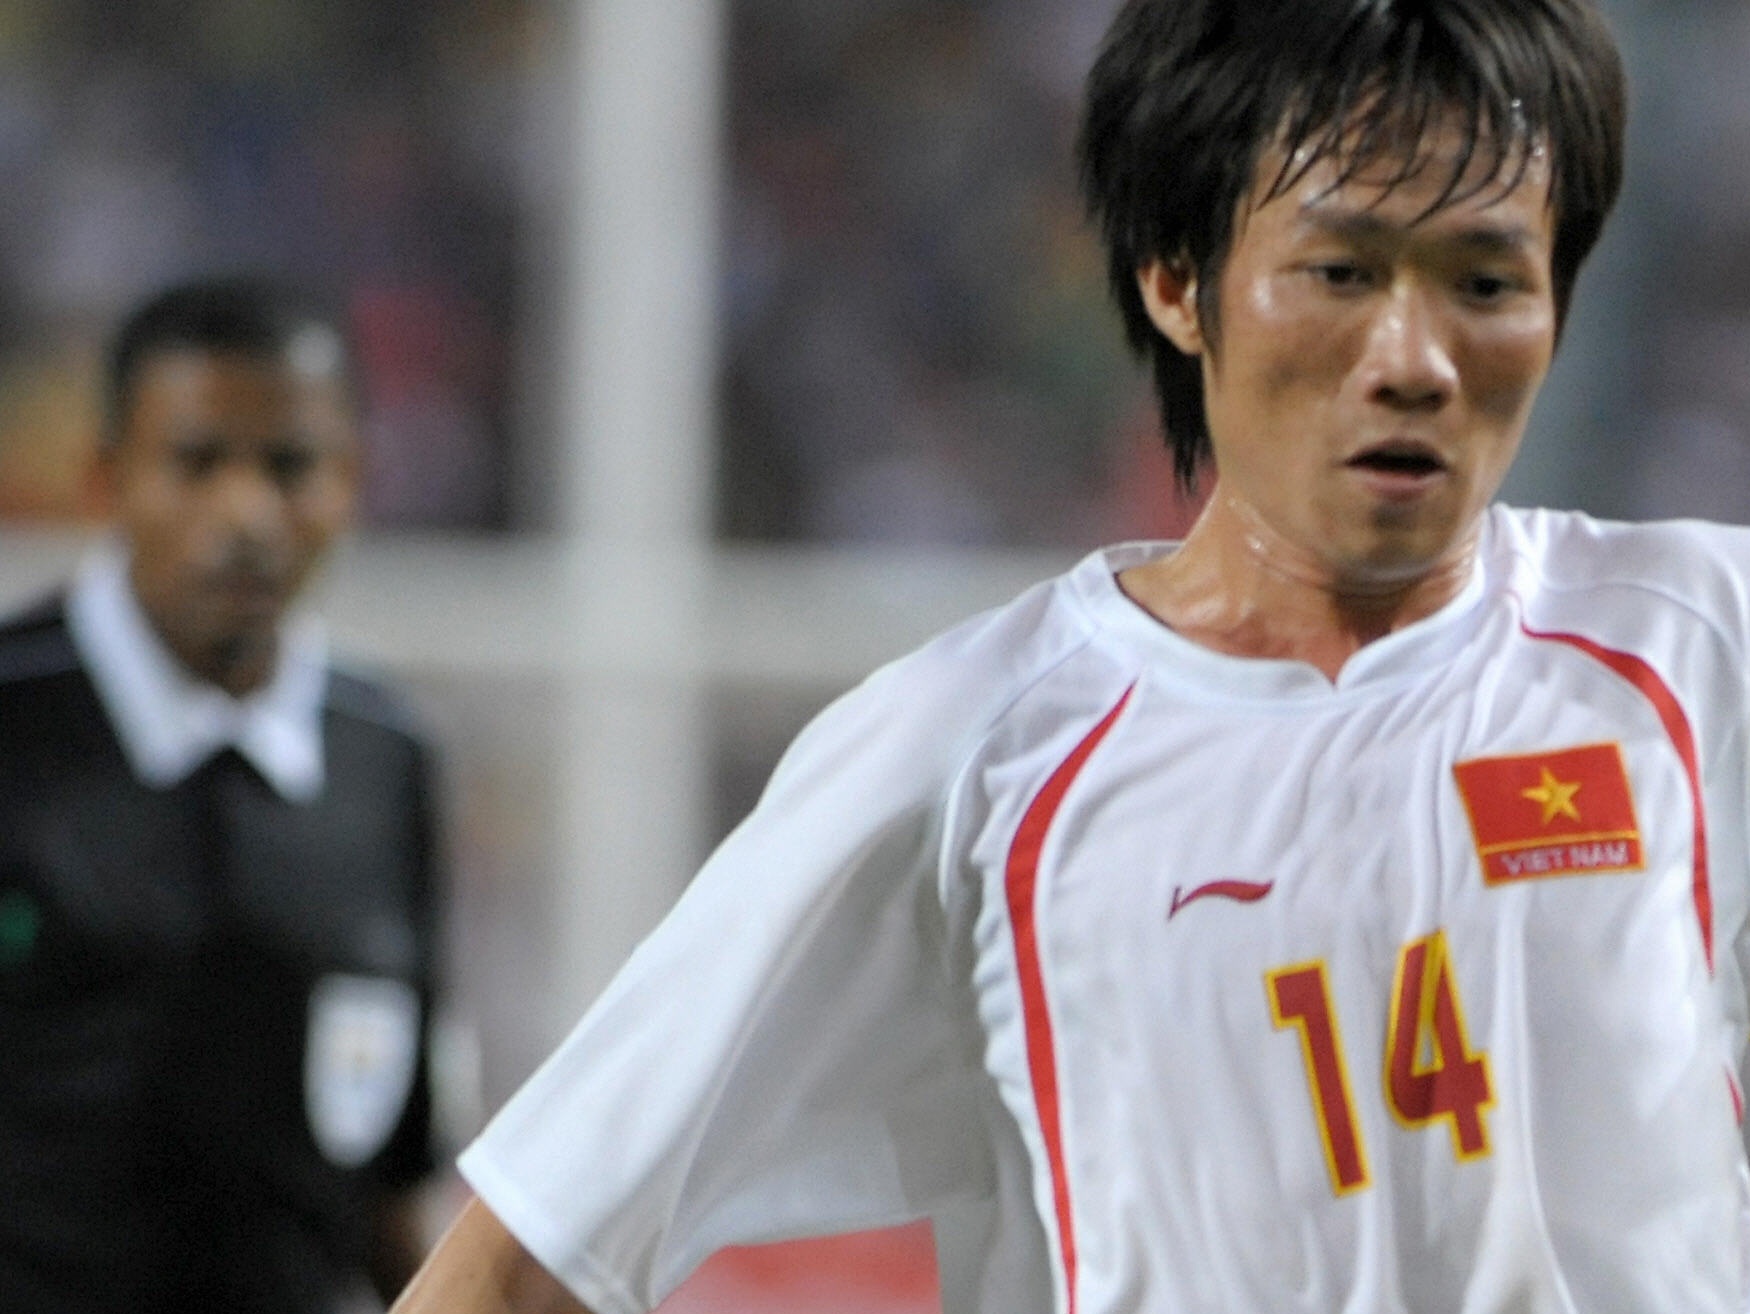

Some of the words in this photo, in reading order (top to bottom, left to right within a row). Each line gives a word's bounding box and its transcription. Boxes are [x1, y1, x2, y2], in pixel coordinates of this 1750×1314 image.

[1501, 847, 1564, 876] VIET
[1568, 841, 1629, 868] NAM
[1264, 929, 1496, 1197] 14
